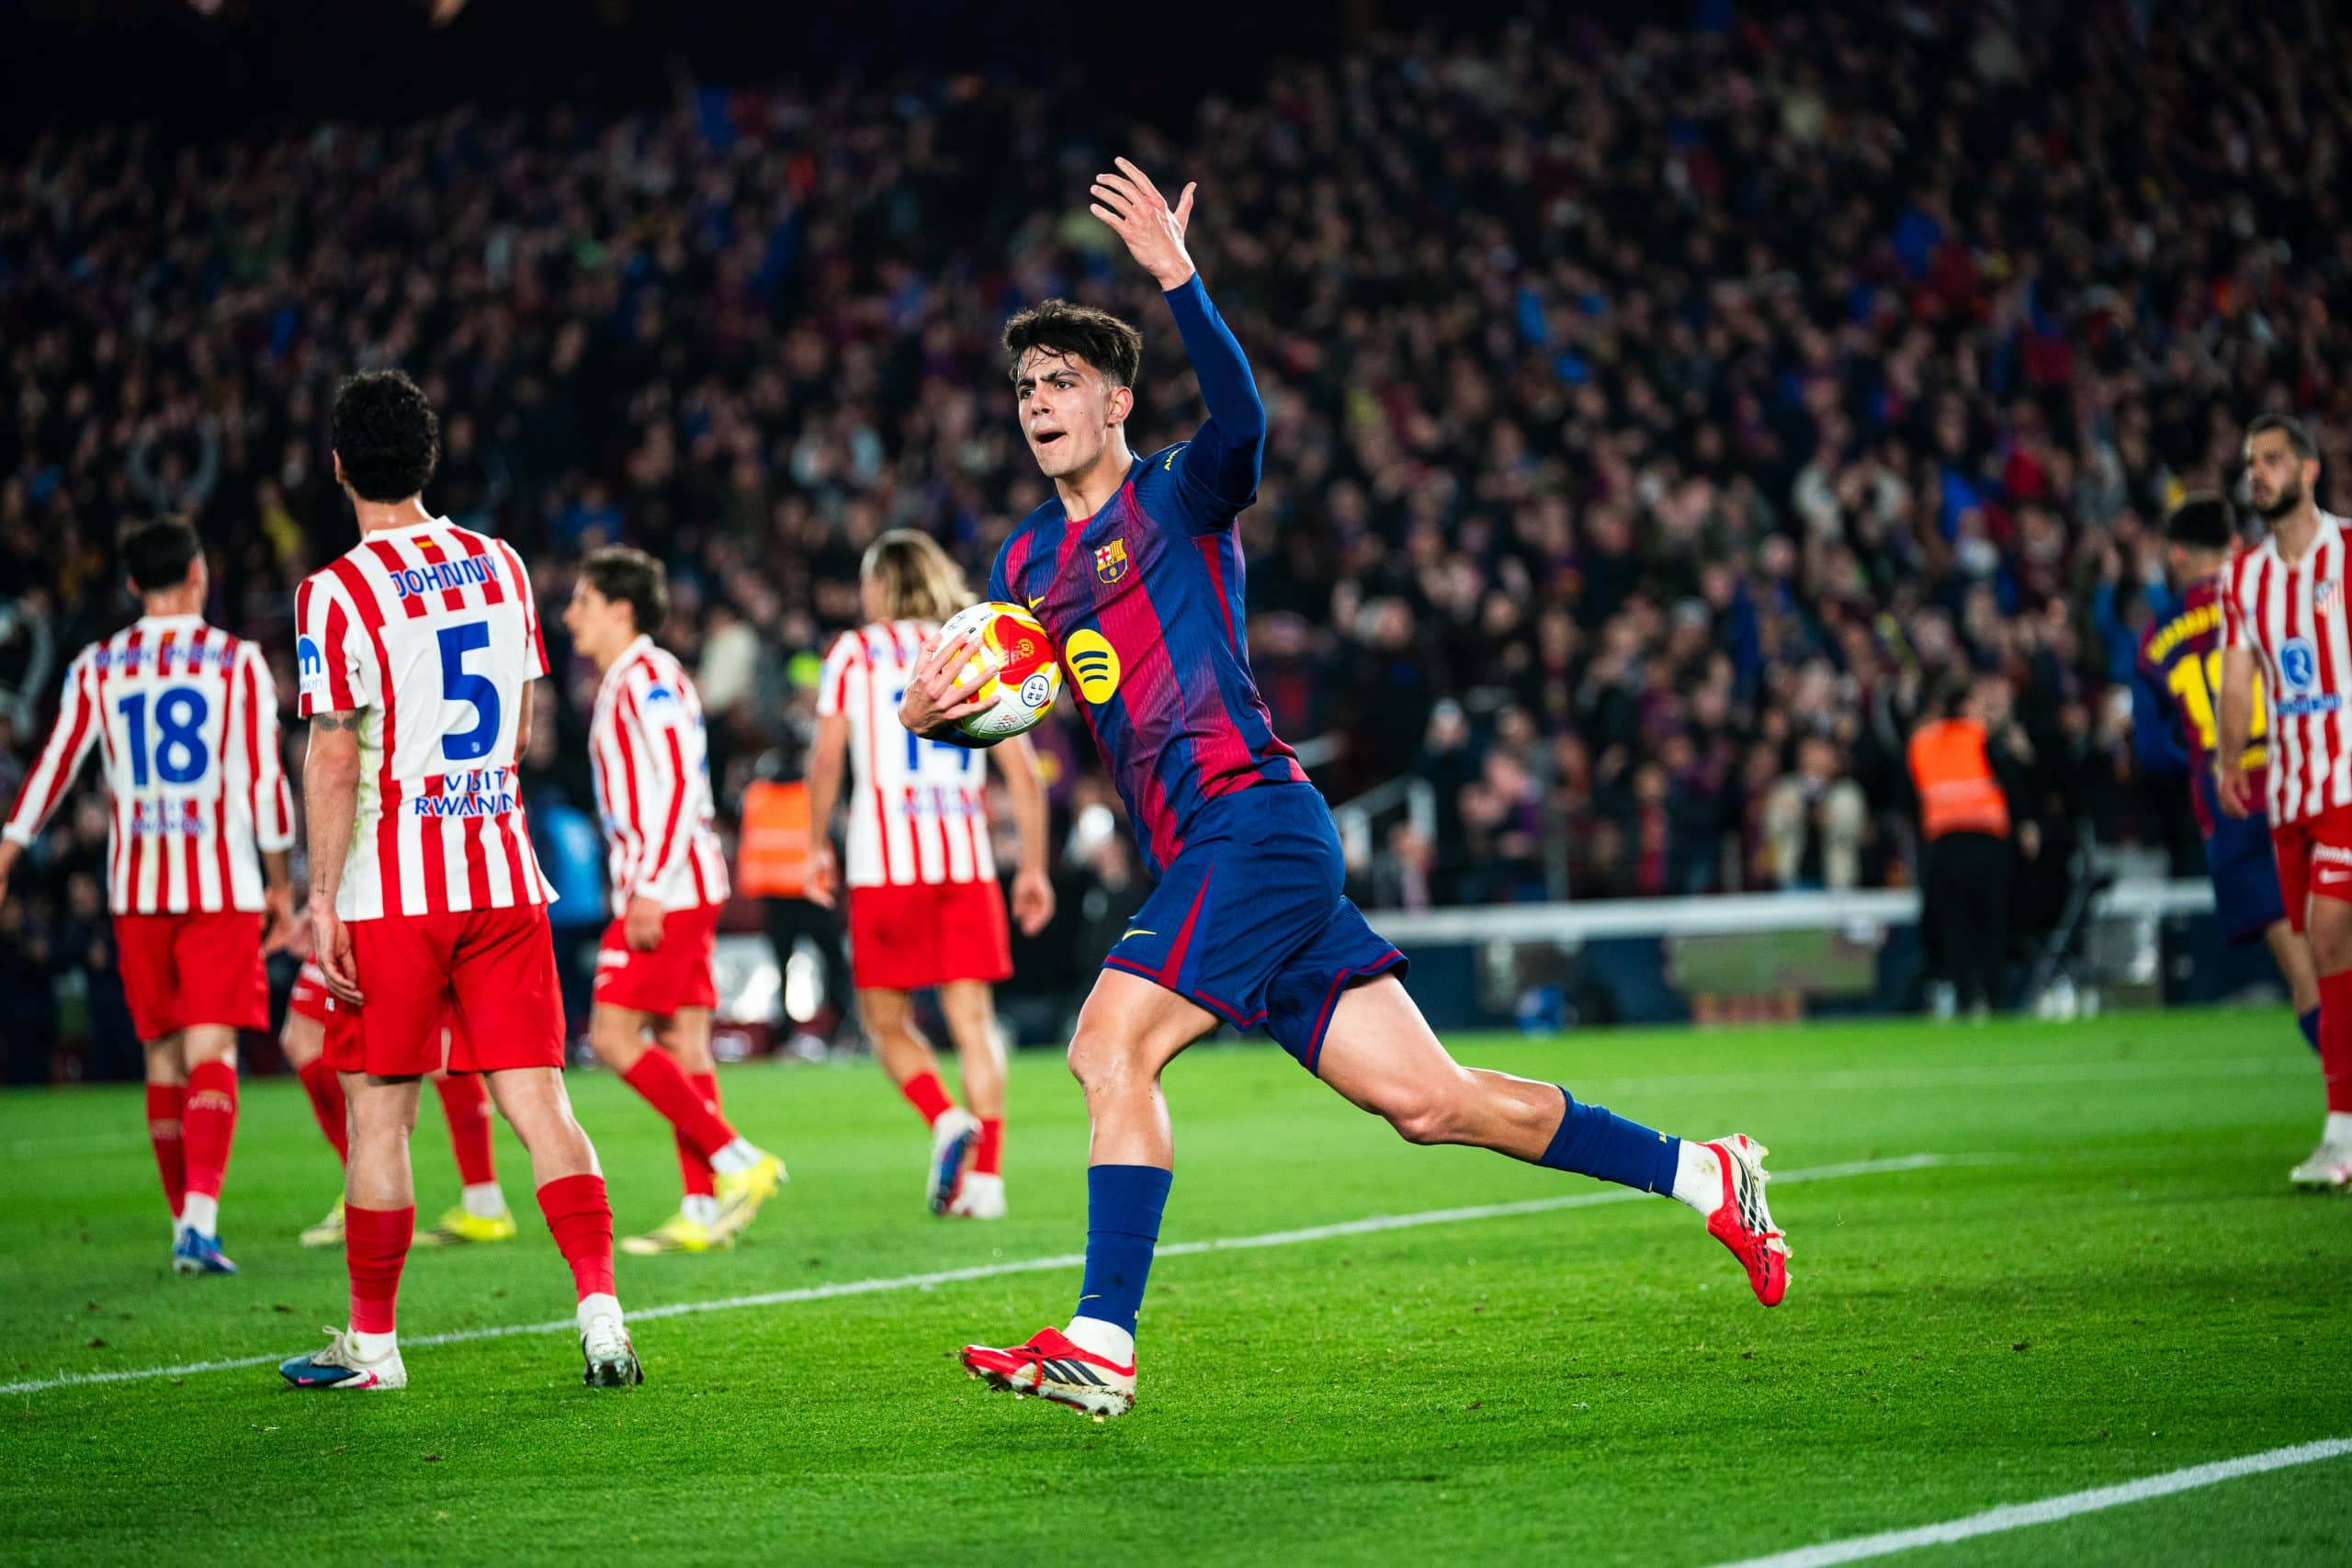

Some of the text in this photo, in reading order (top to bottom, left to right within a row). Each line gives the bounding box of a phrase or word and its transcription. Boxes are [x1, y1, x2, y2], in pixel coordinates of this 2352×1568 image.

[390, 555, 498, 597] JOHNNY
[118, 686, 209, 787] 18
[436, 621, 501, 761] 5
